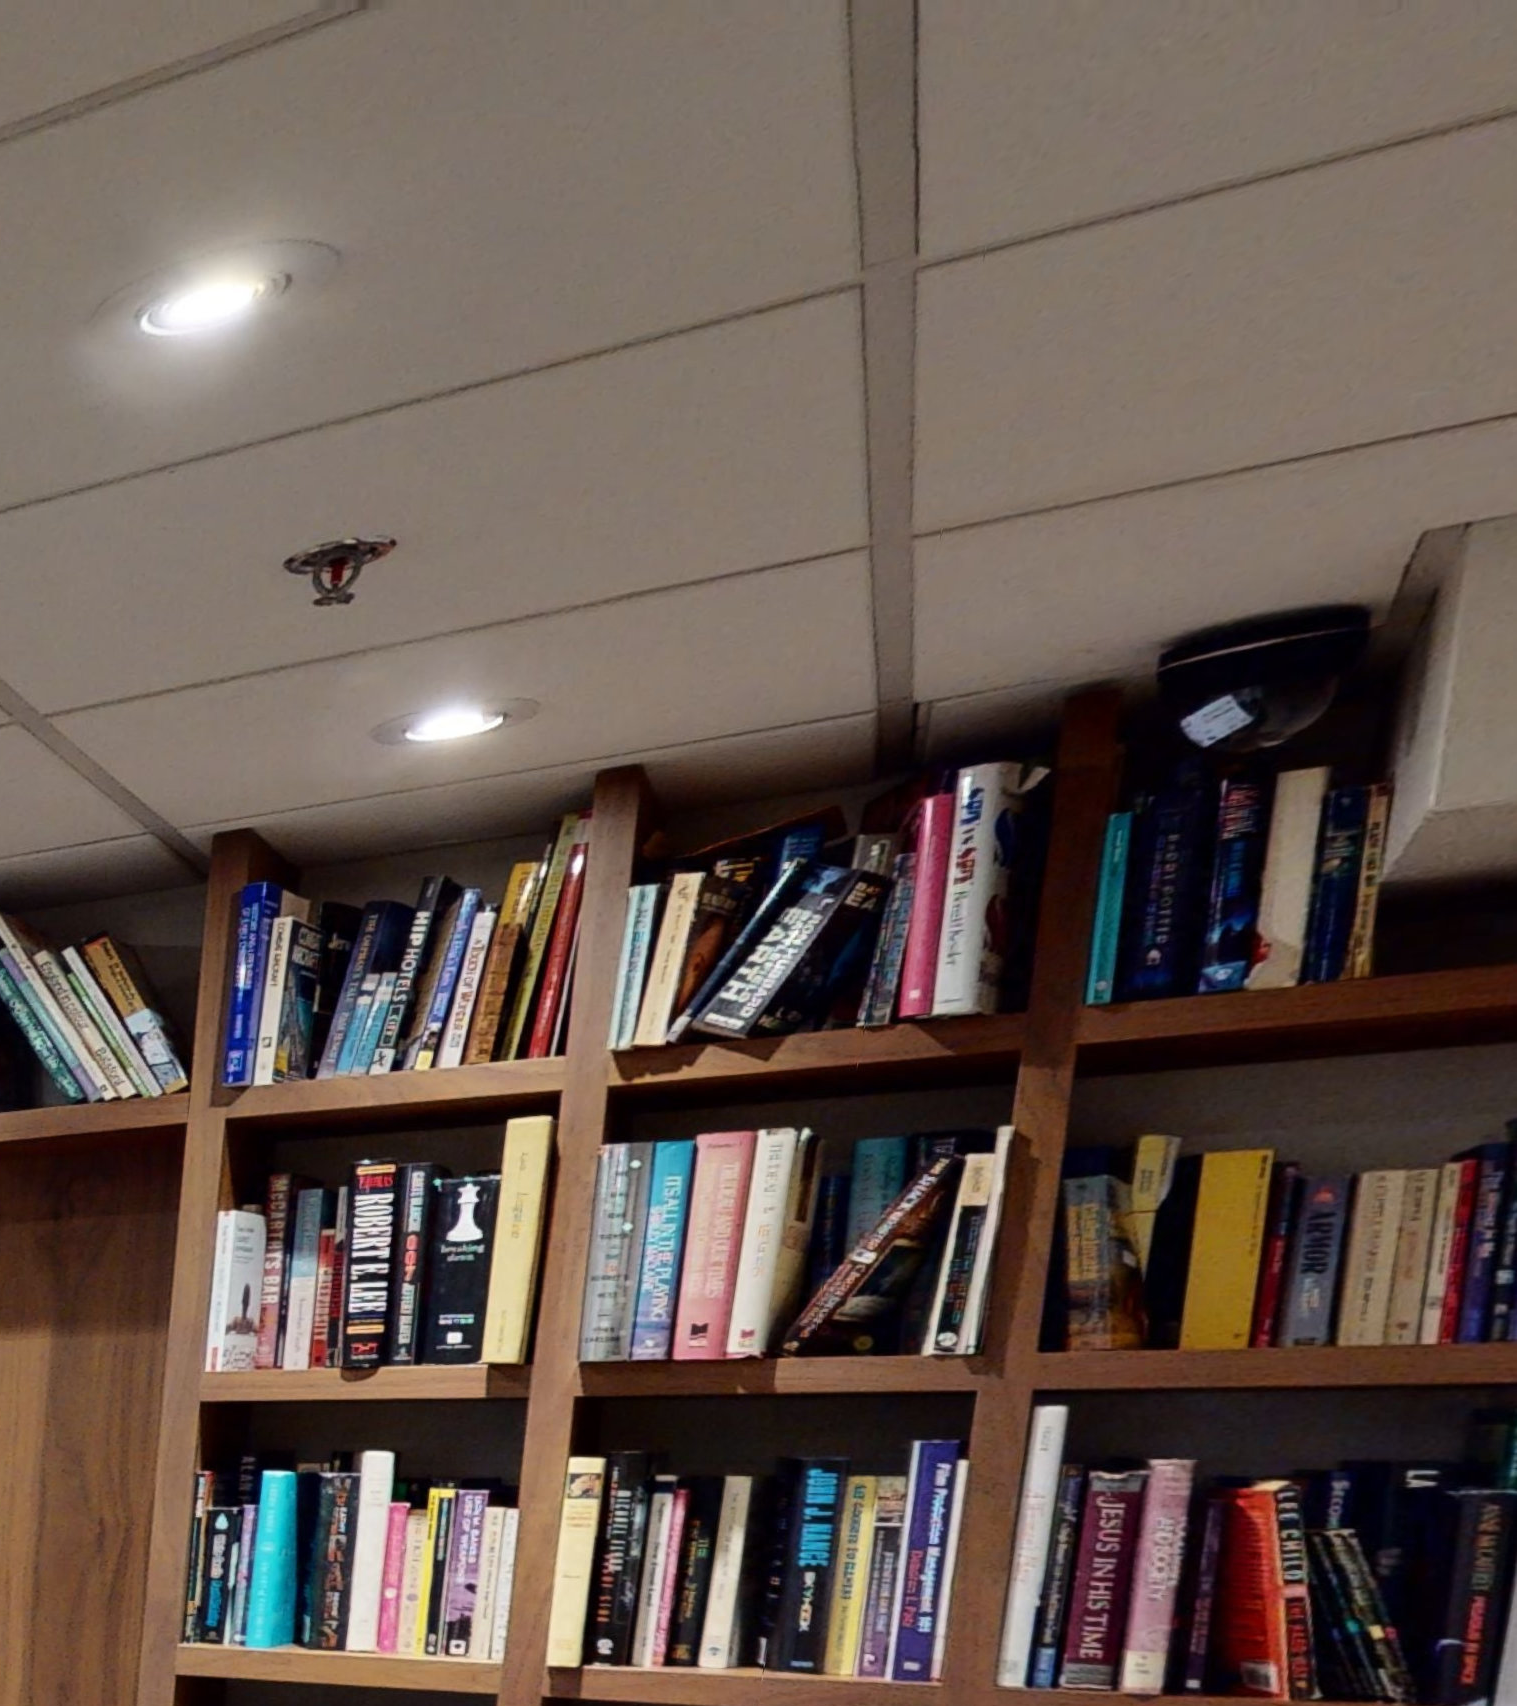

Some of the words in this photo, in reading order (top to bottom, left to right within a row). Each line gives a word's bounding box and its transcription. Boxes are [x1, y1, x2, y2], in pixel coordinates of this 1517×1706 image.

[406, 907, 431, 948] HIP
[389, 944, 420, 1005] HOTELS
[719, 907, 802, 1000] EARTH
[350, 1190, 395, 1260] ROBERT
[1299, 1208, 1337, 1277] ARMOR
[349, 1260, 390, 1282] E.
[402, 1234, 419, 1282] 007
[260, 1274, 281, 1305] BAR
[347, 1278, 388, 1317] LEE
[649, 1265, 672, 1322] PLAYING
[803, 1467, 838, 1506] JOHN
[1276, 1490, 1302, 1521] LEE
[797, 1521, 832, 1569] NANCE
[1088, 1494, 1127, 1554] JESUS
[1090, 1554, 1118, 1580] IN
[1280, 1527, 1307, 1581] CHILD
[1084, 1578, 1113, 1612] HIS
[1077, 1610, 1109, 1663] TIME
